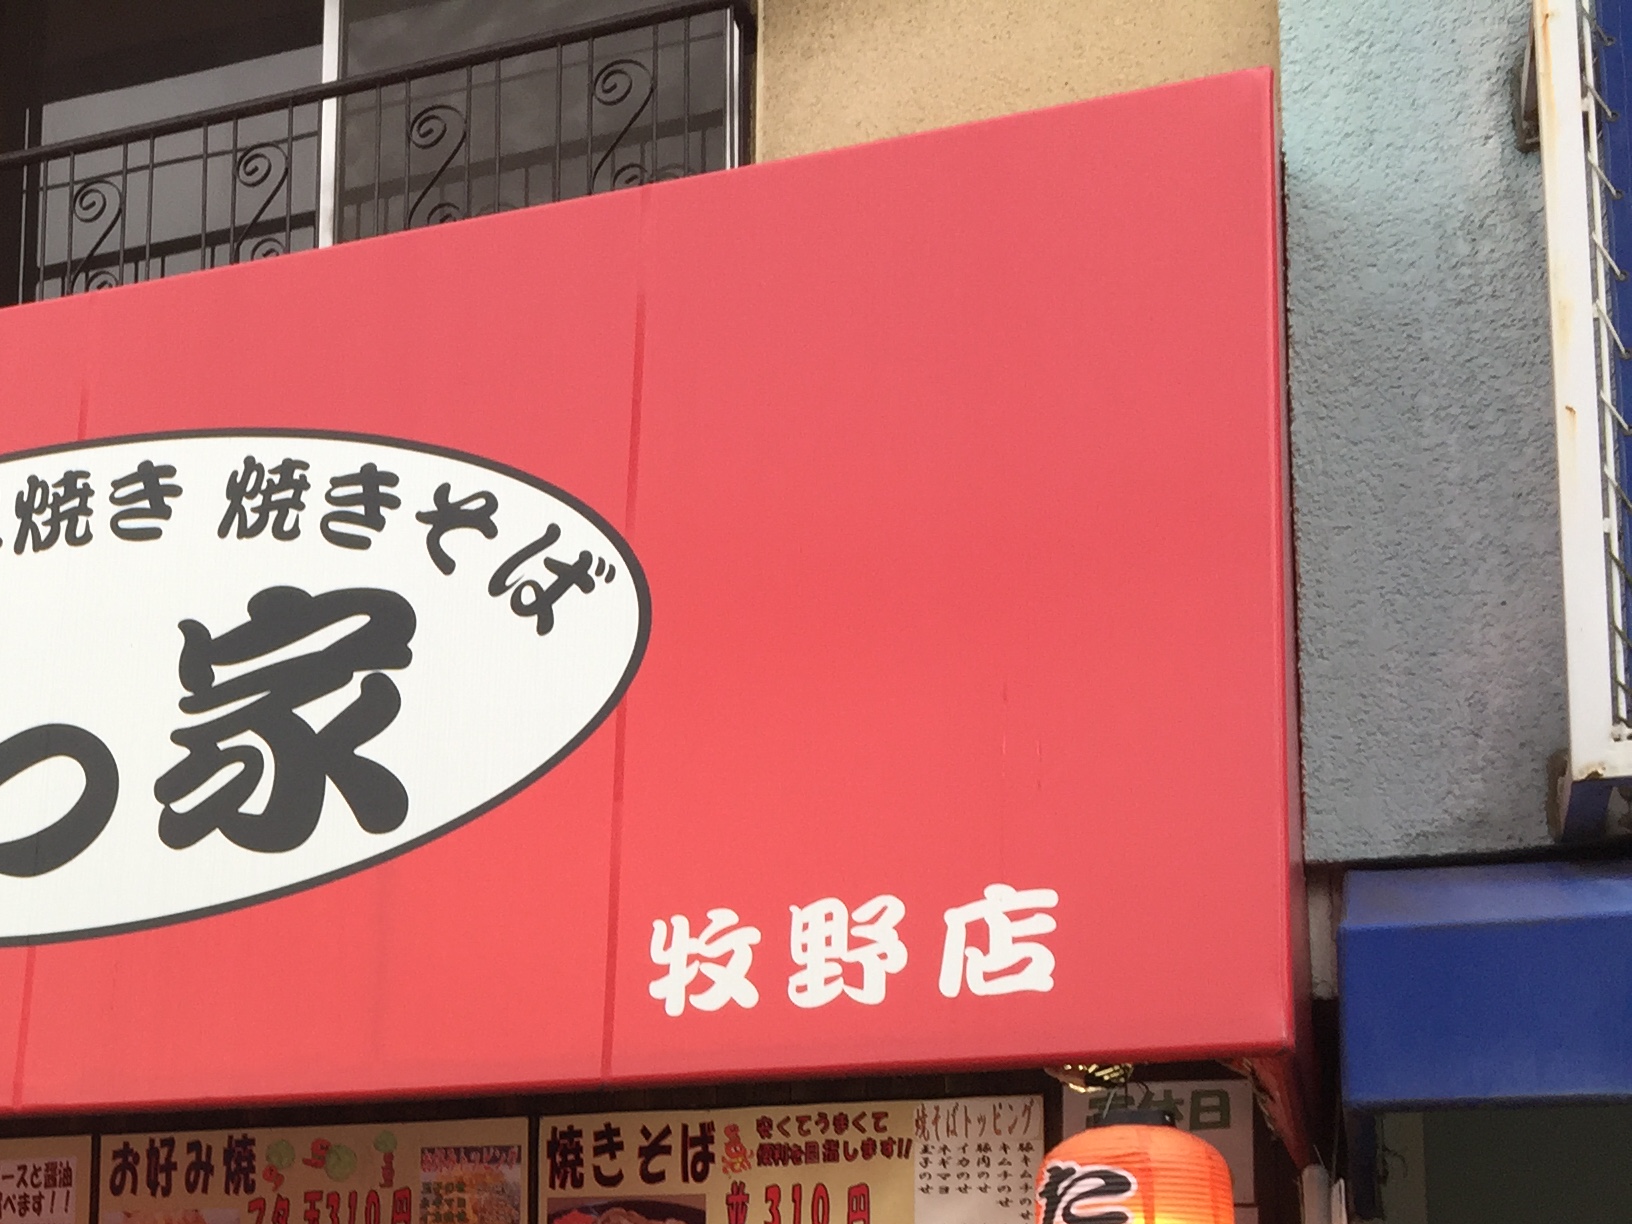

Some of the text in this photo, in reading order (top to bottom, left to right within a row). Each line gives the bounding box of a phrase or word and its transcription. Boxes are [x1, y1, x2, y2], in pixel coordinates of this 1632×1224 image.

[218, 456, 617, 637] 焼きそば
[649, 883, 1059, 1017] 牧野店
[546, 1121, 716, 1191] 焼きそば
[756, 1111, 889, 1139] 安くてうまくて
[109, 1133, 257, 1198] お好み焼
